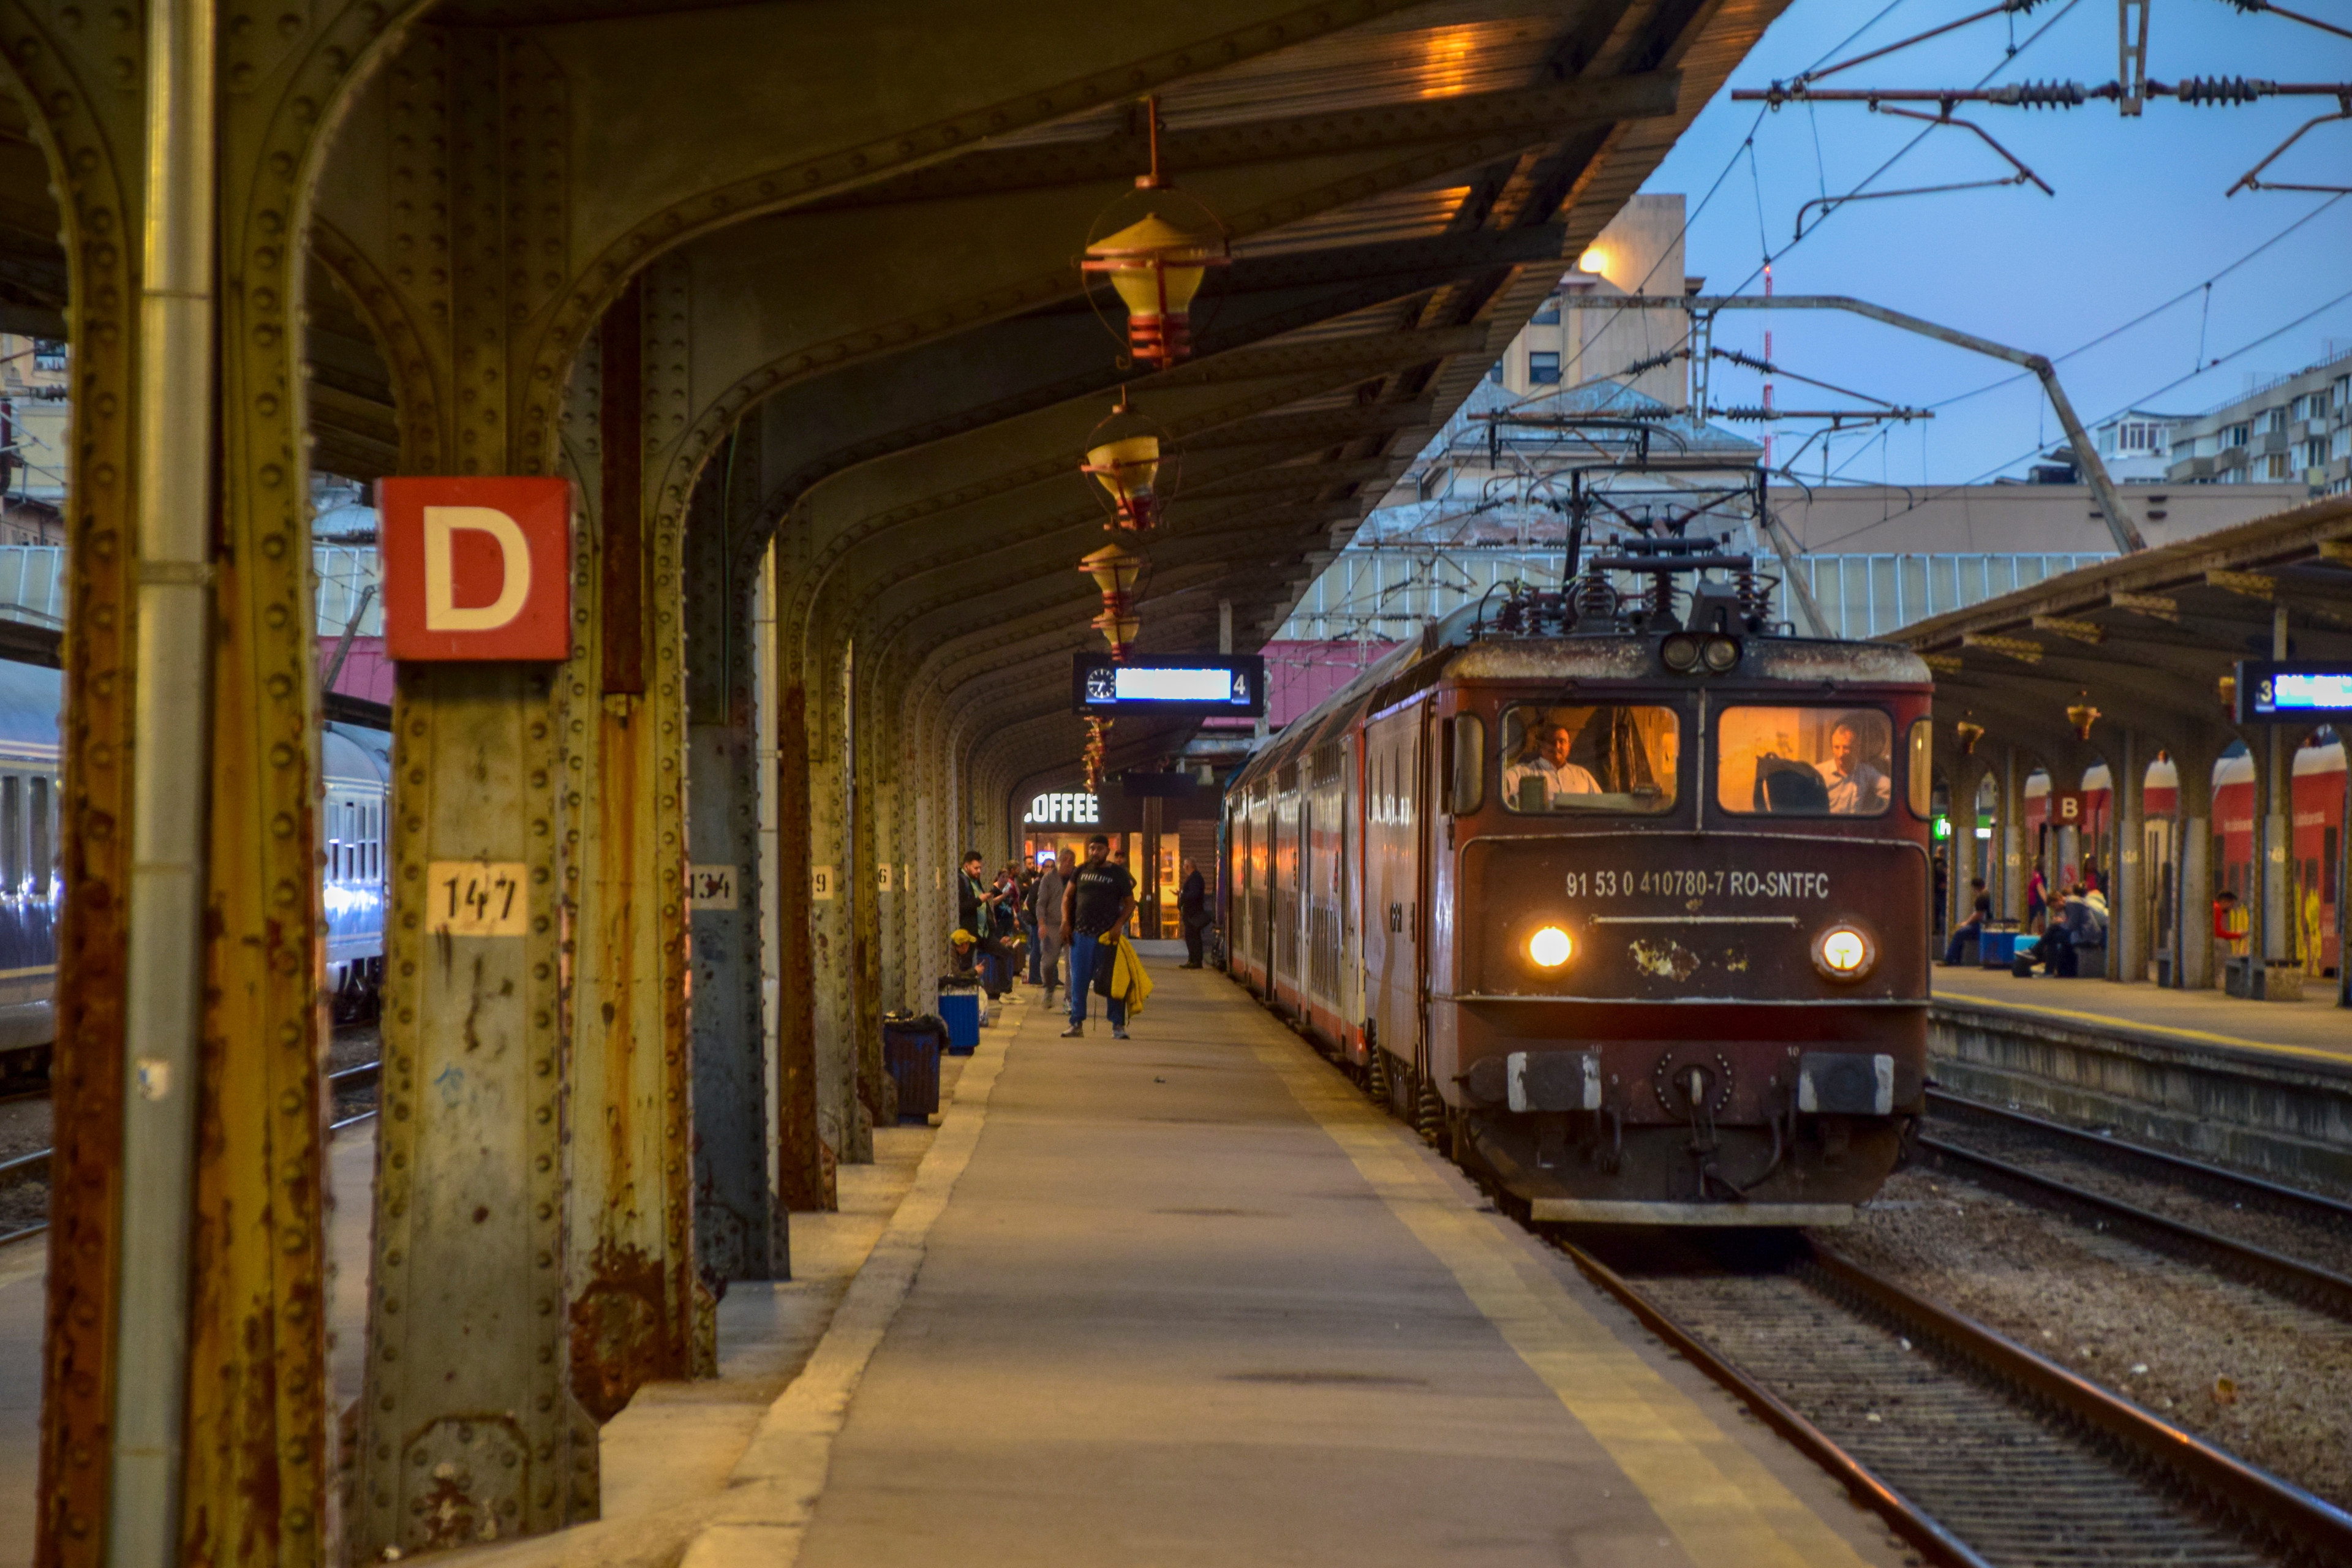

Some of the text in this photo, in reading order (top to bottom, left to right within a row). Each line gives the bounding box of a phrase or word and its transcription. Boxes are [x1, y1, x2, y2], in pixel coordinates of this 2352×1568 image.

[423, 506, 531, 631] D
[1234, 674, 1246, 695] 4
[2260, 680, 2272, 702] 3
[2062, 797, 2078, 818] B
[1567, 870, 1829, 899] 91 53 0 410780-7 RO-SNTFC
[443, 876, 516, 920] 147
